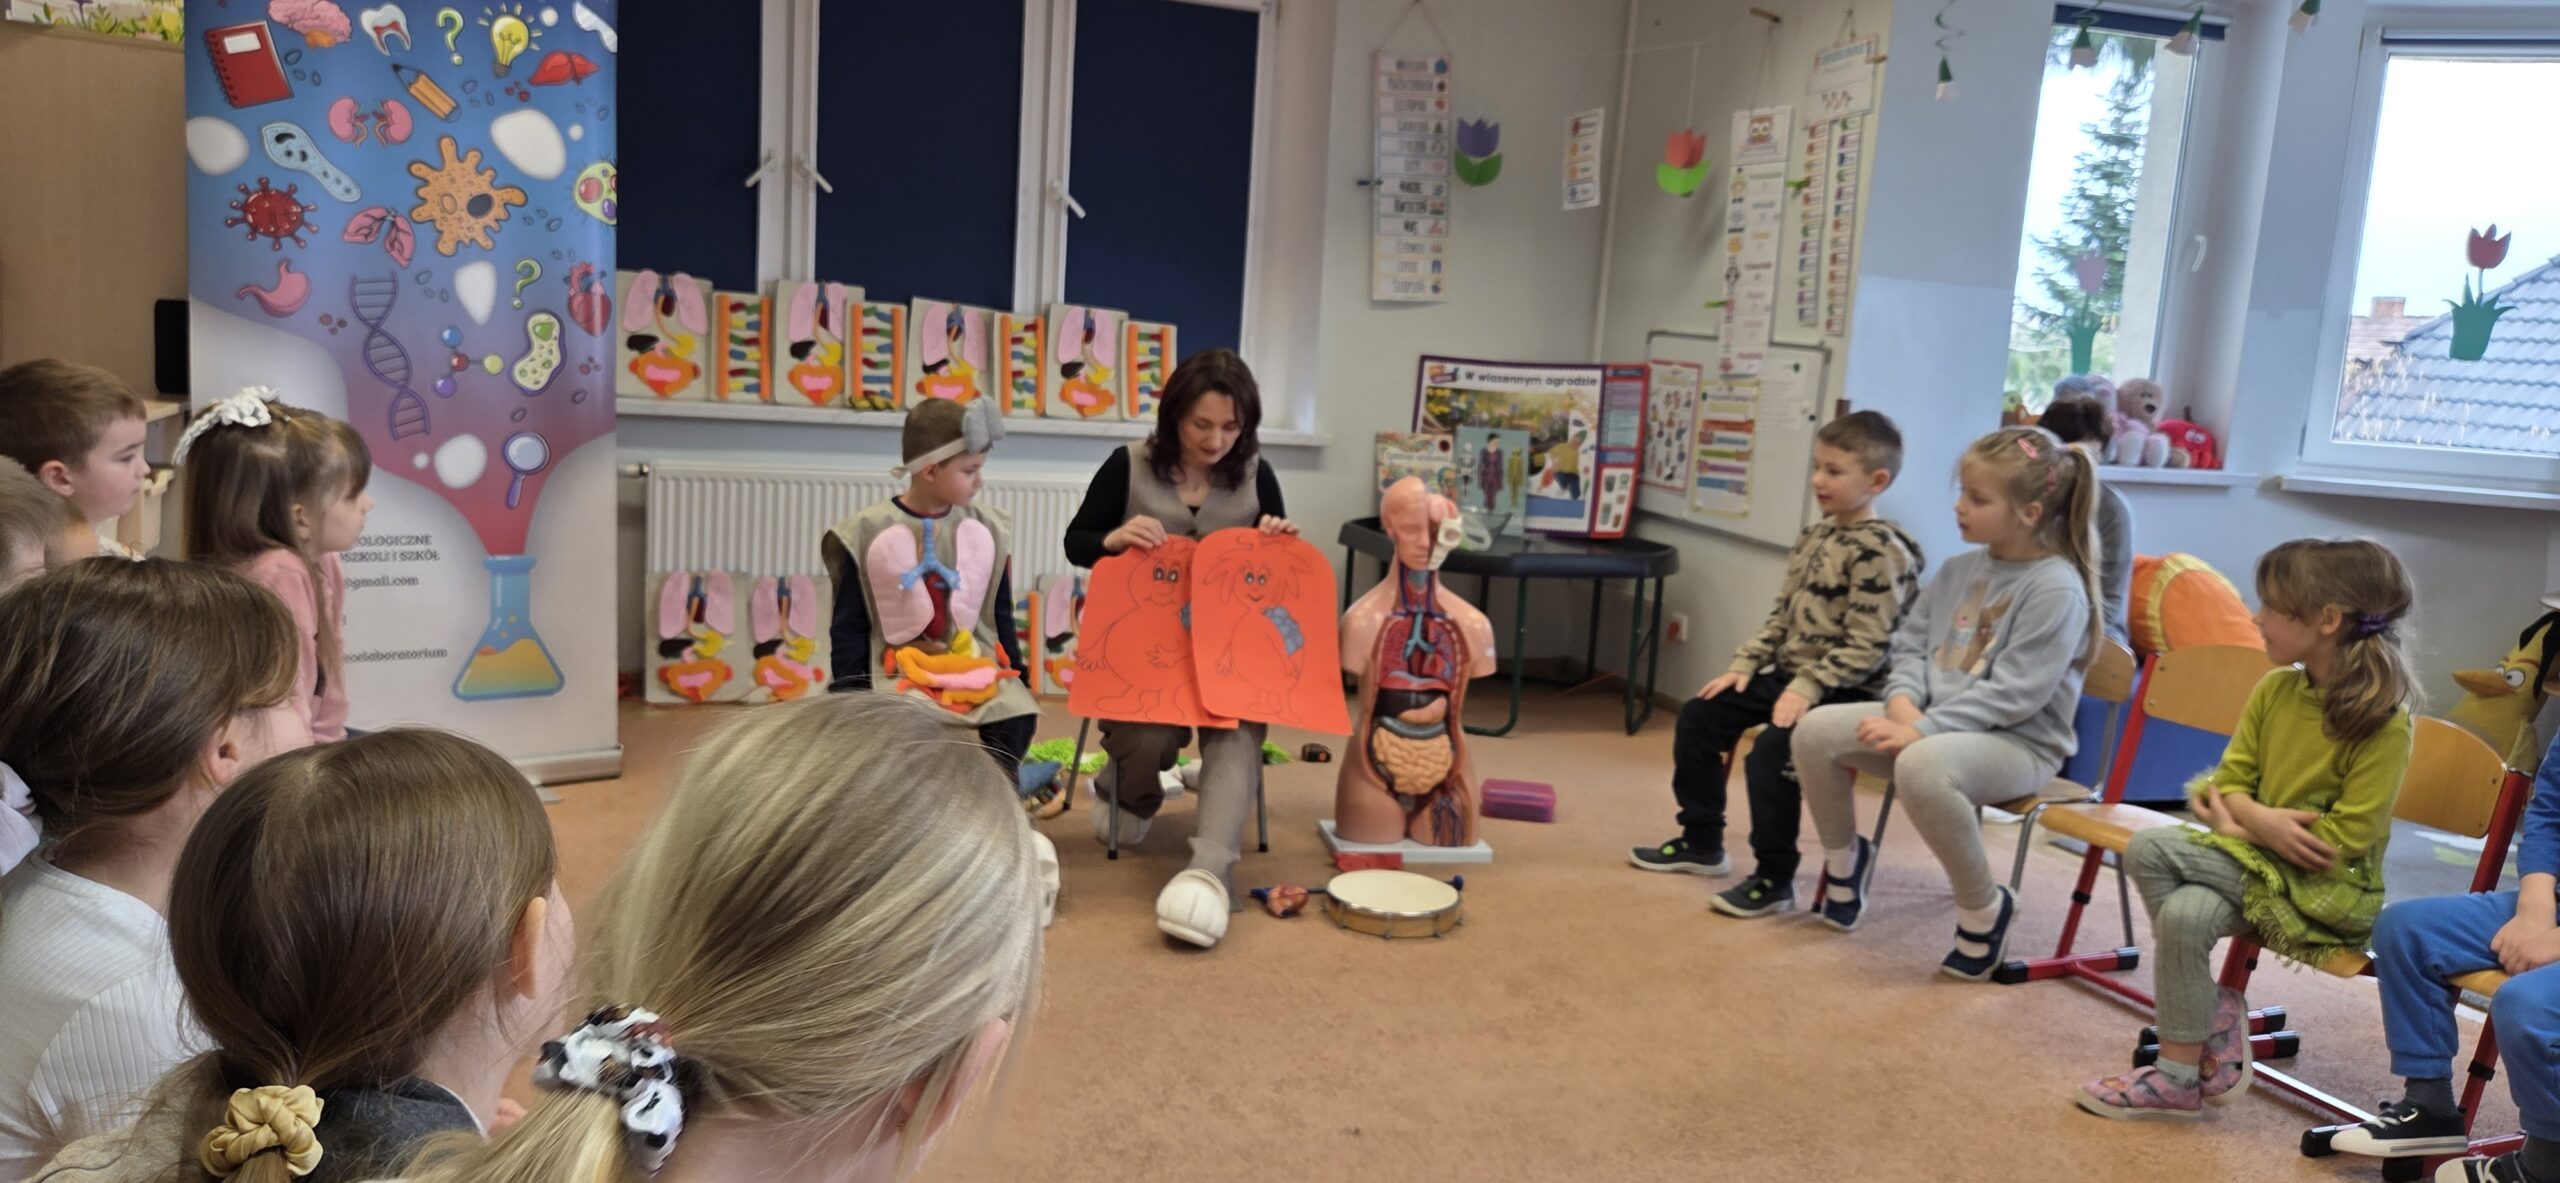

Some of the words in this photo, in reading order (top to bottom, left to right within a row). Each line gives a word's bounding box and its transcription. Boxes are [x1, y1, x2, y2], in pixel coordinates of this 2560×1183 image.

[1465, 371, 1474, 381] W
[1478, 373, 1541, 386] wiosennym
[1546, 375, 1597, 387] ogrodzie
[358, 534, 432, 547] OLOGICZNE
[341, 551, 390, 562] SZKOLI
[399, 549, 440, 562] SZKÓŁ
